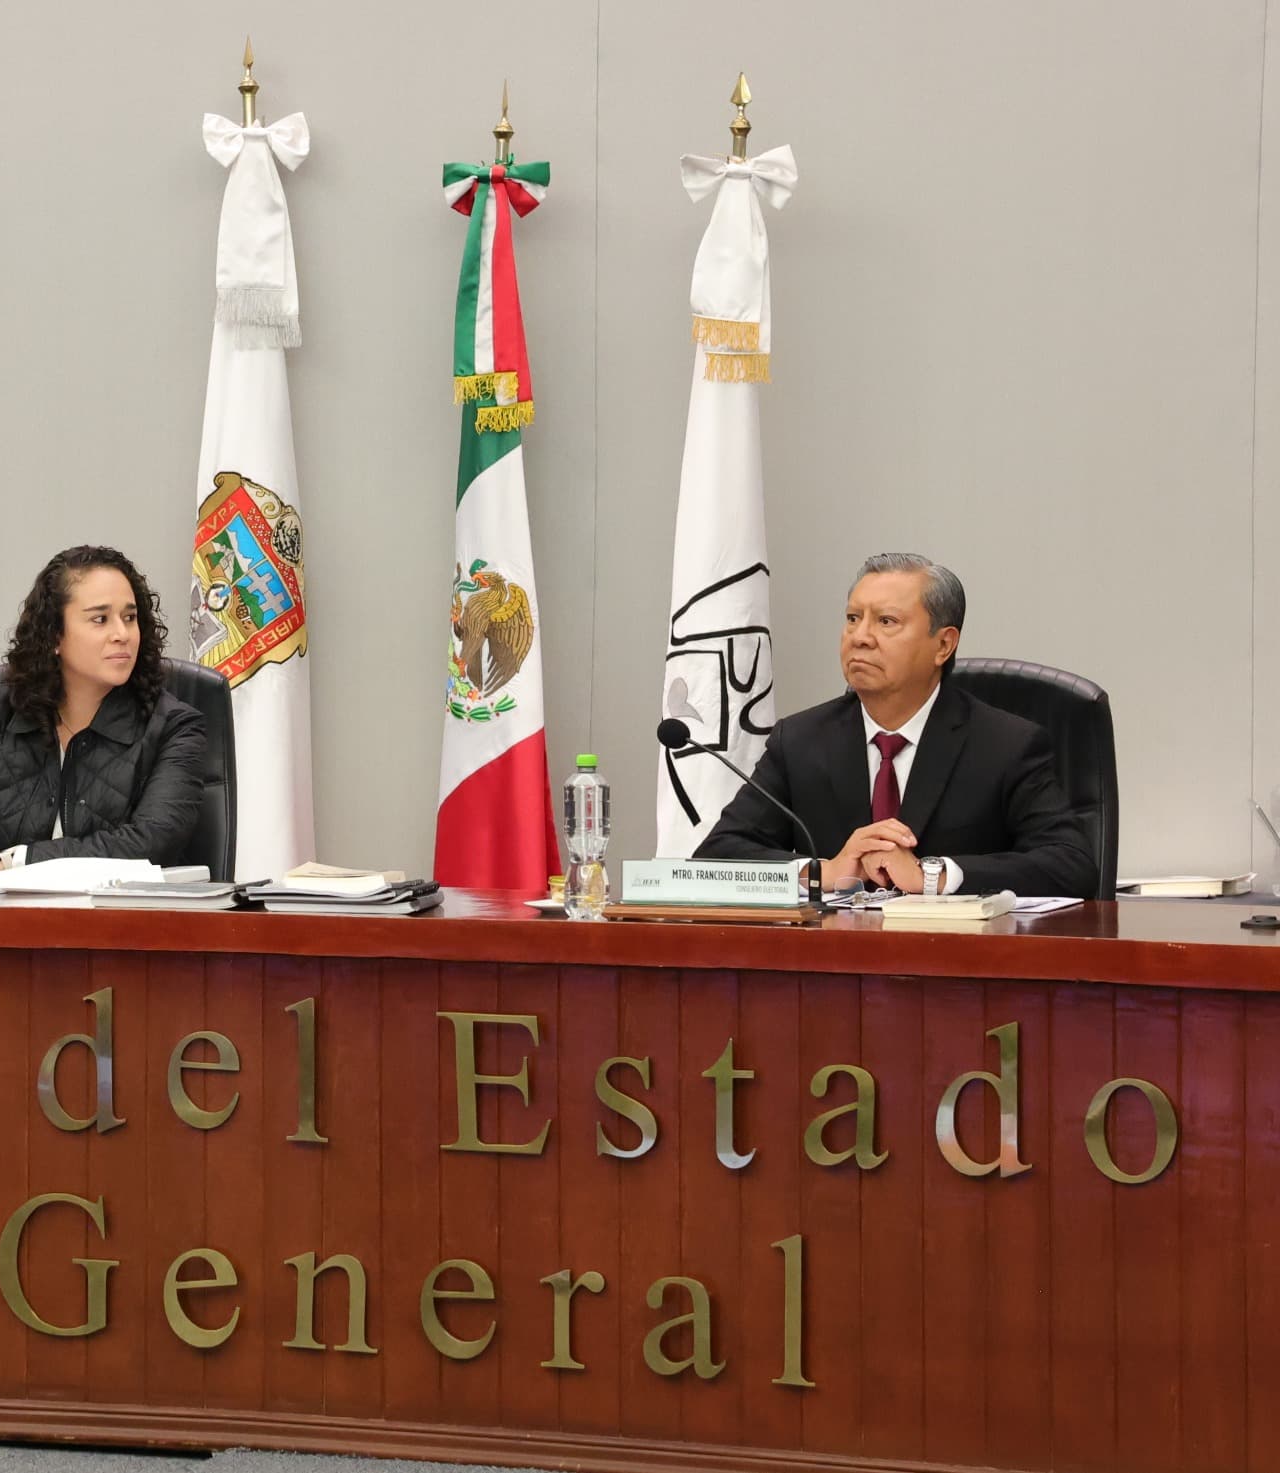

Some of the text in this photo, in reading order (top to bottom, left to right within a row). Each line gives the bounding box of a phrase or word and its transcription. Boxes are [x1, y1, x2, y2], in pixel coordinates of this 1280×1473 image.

[672, 869, 789, 883] MTRO. FRANCISCO BELLO CORONA
[37, 986, 329, 1143] del
[436, 1011, 1178, 1184] Estado
